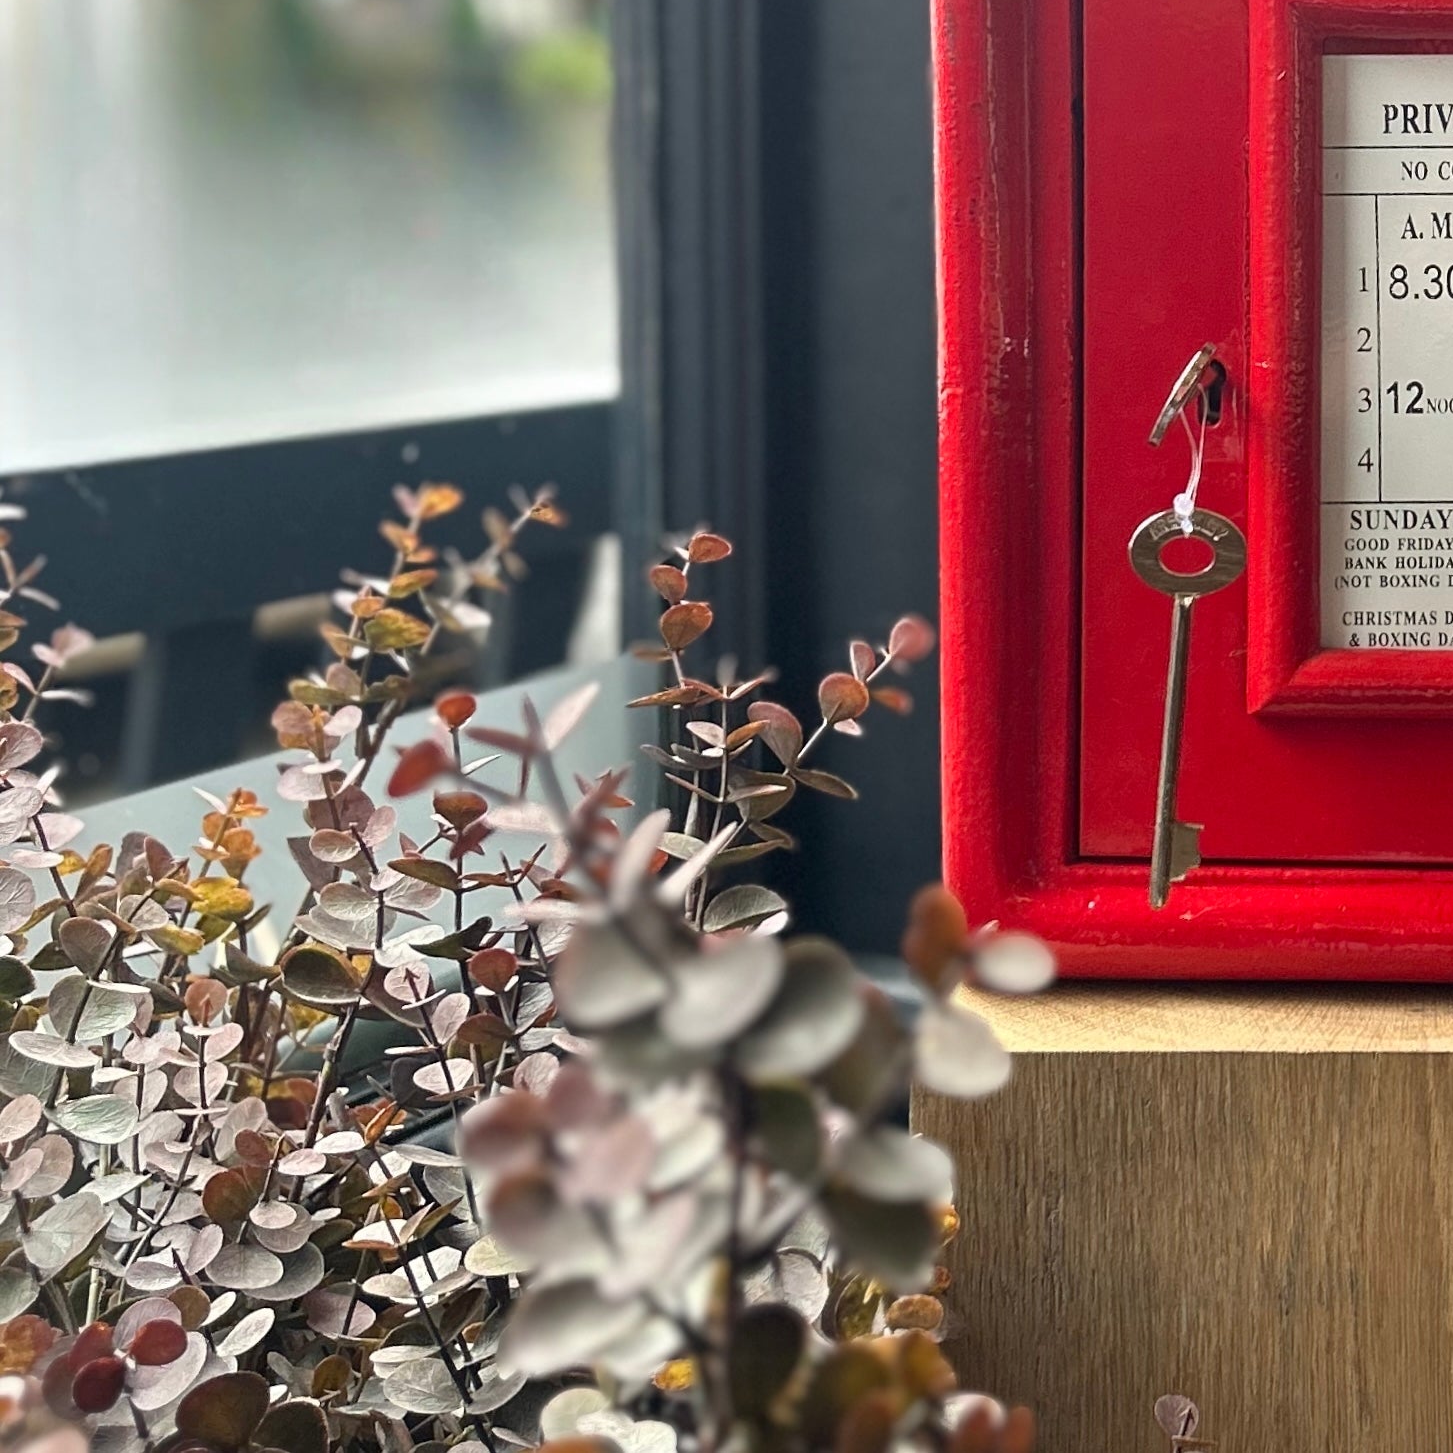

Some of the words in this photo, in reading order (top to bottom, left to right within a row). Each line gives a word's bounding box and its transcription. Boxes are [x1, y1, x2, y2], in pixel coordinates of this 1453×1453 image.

[1401, 161, 1429, 181] NO
[1359, 266, 1369, 293] 1
[1356, 327, 1373, 353] 2
[1358, 387, 1372, 413] 3
[1357, 447, 1374, 473] 4
[1344, 537, 1390, 551] GOOD
[1344, 556, 1387, 570] BANK
[1334, 575, 1372, 590] (NOT
[1379, 574, 1440, 588] BOXING
[1342, 611, 1438, 626] CHRISTMAS
[1348, 632, 1361, 648] &
[1368, 631, 1431, 648] BOXING
